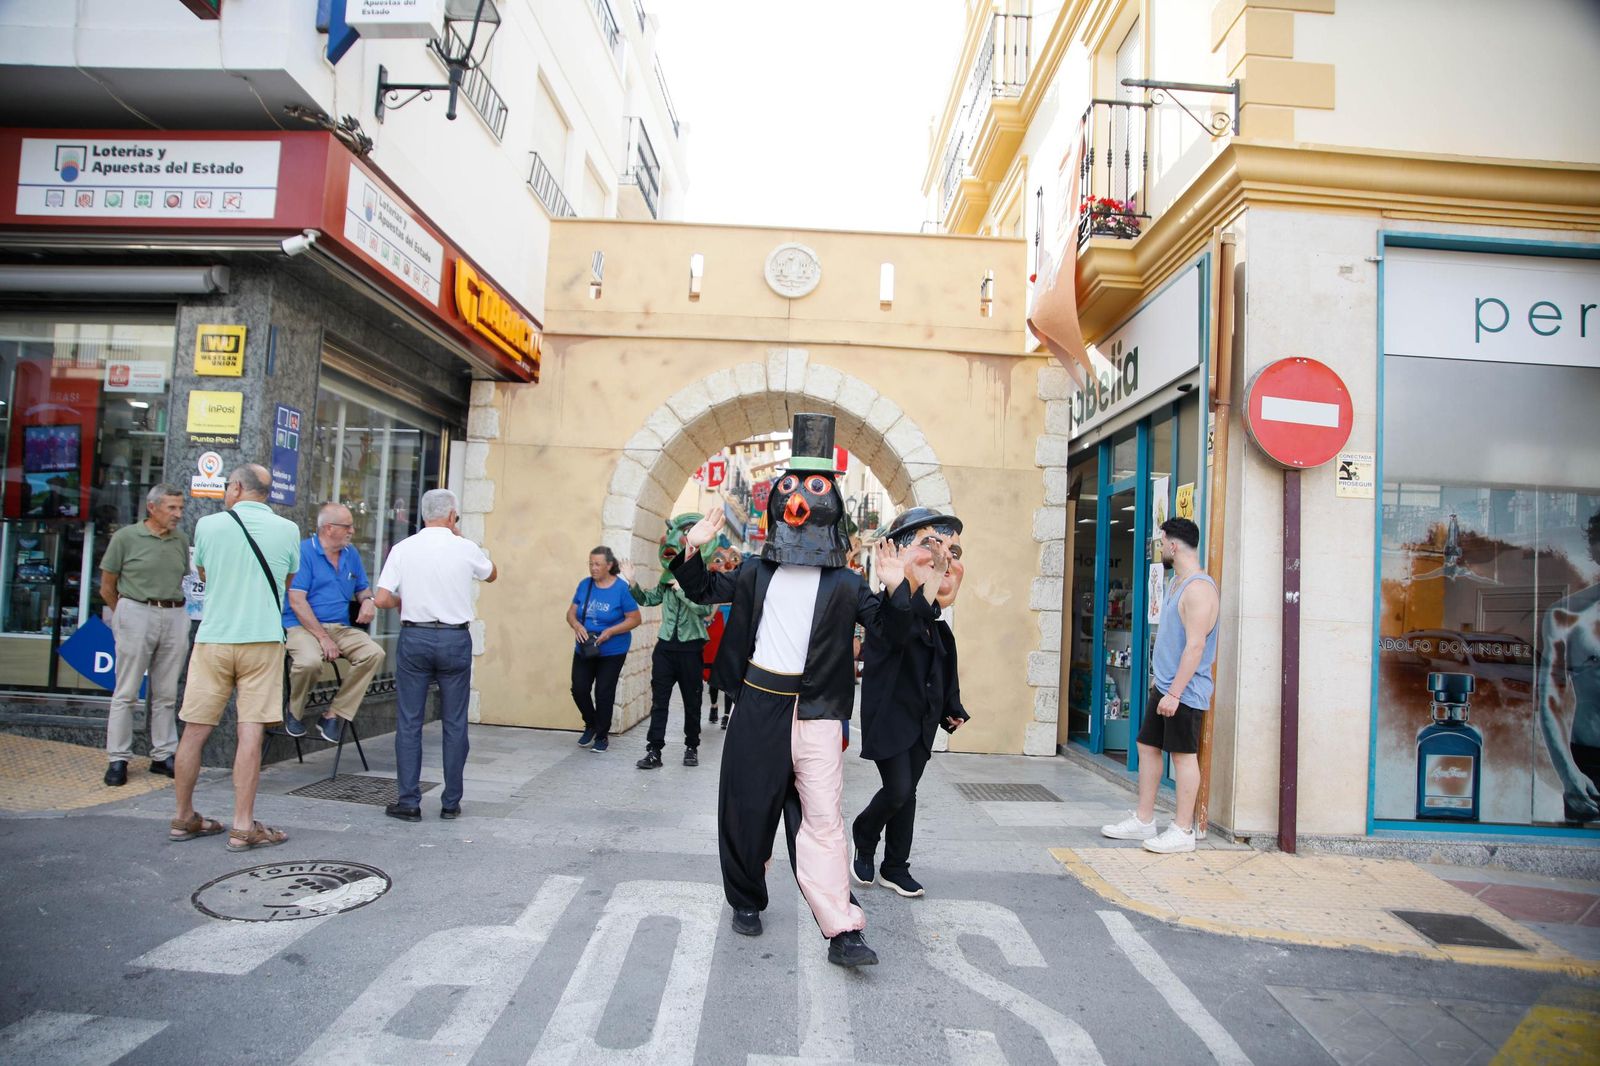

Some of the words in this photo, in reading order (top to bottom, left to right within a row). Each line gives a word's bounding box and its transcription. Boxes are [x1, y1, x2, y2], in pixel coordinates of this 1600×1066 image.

[92, 145, 153, 158] Loterías
[156, 147, 166, 160] y
[92, 161, 161, 176] Apuestas
[165, 162, 187, 174] del
[192, 162, 244, 175] Estado
[377, 211, 405, 241] Apuestas
[405, 233, 414, 249] del
[414, 242, 432, 264] Estado
[1475, 297, 1598, 344] per
[206, 335, 236, 351] WU
[191, 435, 215, 443] Punto
[215, 436, 235, 444] Pack
[192, 582, 206, 592] 25
[1439, 640, 1532, 657] DOMINGUEZ
